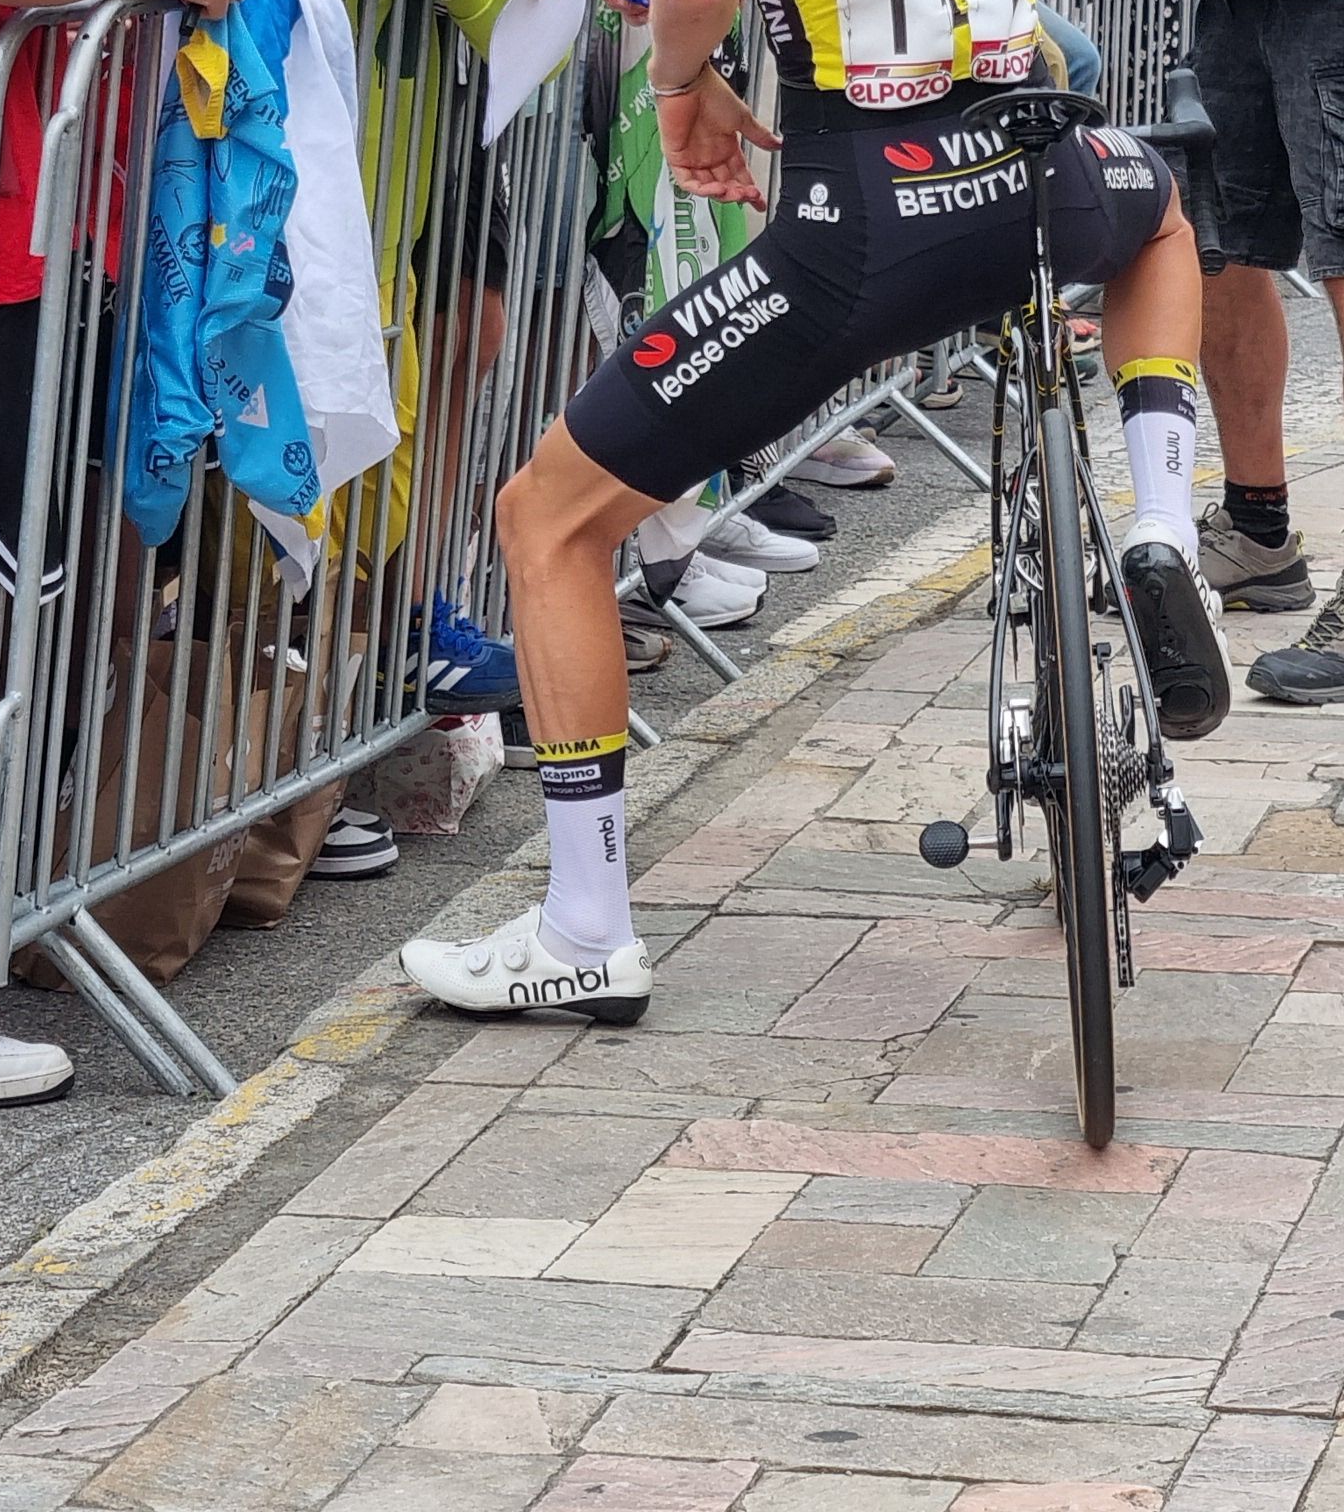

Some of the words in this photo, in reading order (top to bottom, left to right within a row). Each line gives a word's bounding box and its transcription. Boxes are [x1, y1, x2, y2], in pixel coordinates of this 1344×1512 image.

[938, 128, 1005, 167] VIS
[895, 159, 1029, 218] BETCITY.
[797, 204, 840, 223] AGU
[672, 255, 771, 338] VISMA
[1166, 430, 1183, 477] nimbl
[547, 738, 601, 755] VISMA
[542, 768, 596, 783] scapino
[597, 814, 618, 863] nimbl
[508, 962, 610, 1005] nimbl
